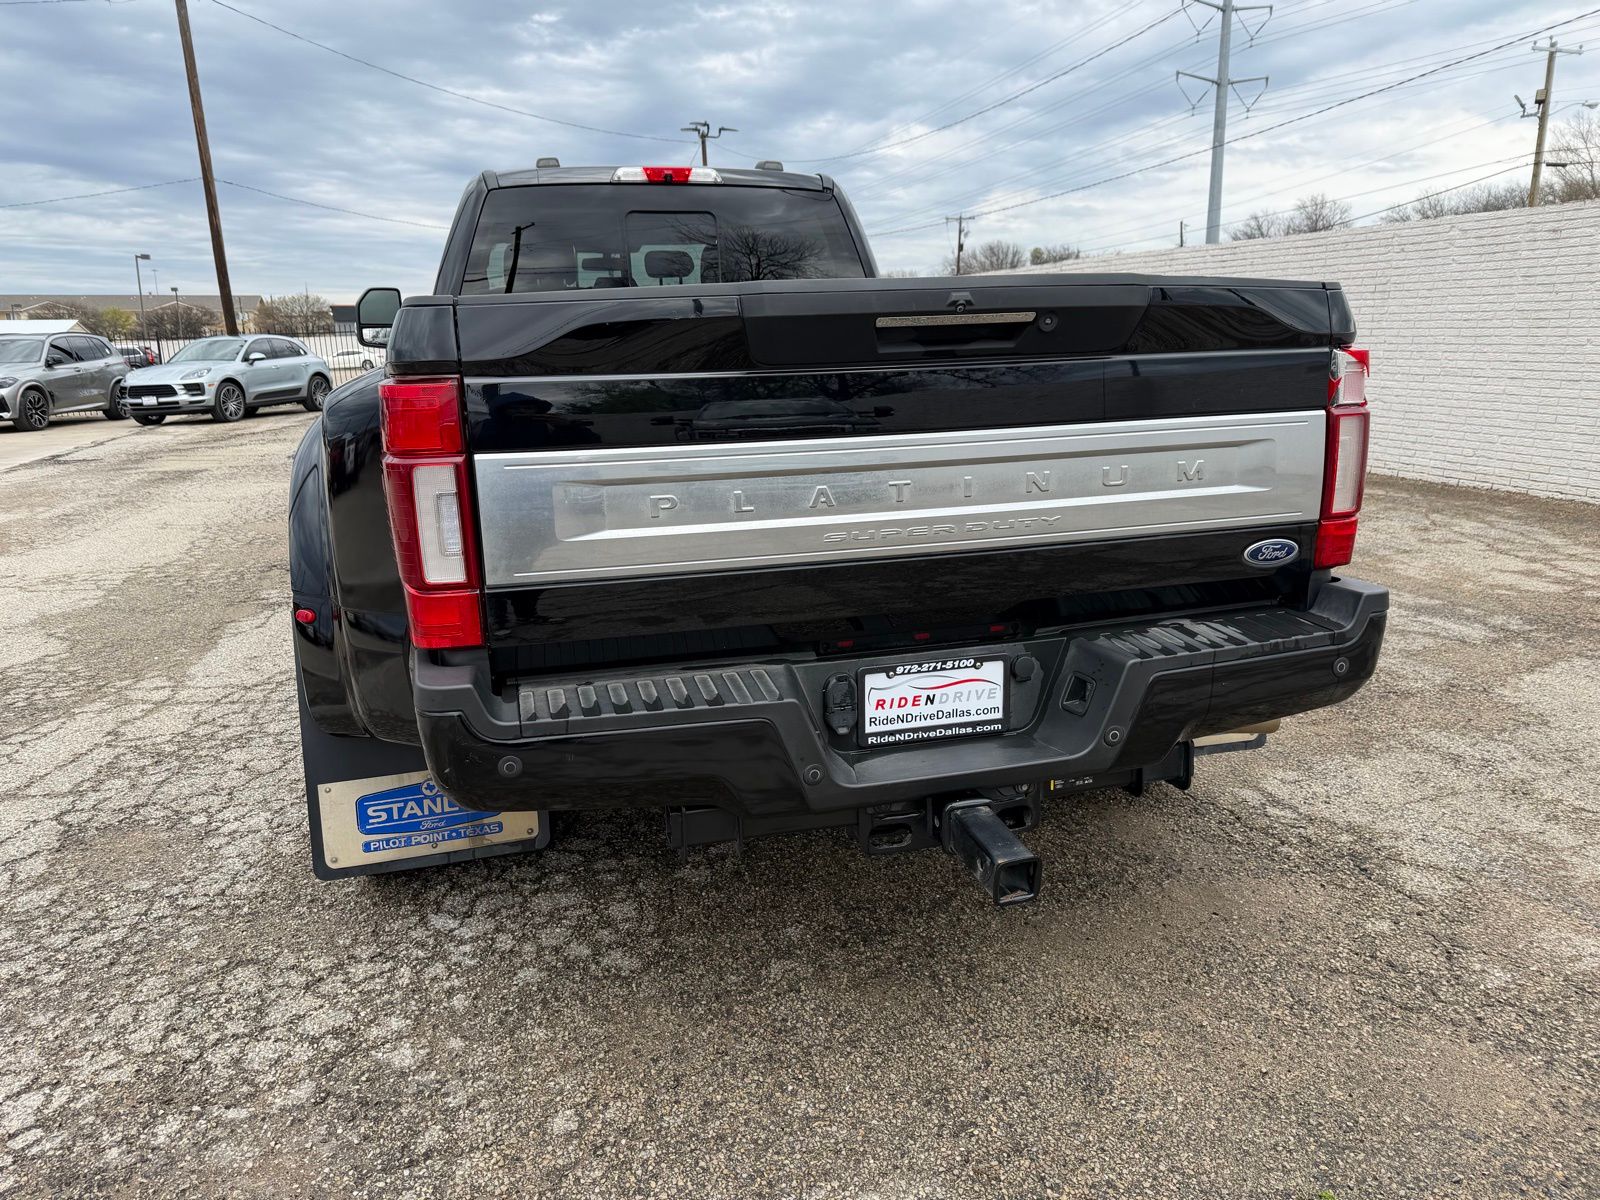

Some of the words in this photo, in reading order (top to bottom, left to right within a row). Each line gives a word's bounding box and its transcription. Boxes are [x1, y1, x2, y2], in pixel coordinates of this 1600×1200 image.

[649, 459, 1205, 519] PLATINUM
[823, 524, 955, 543] SUPER
[965, 515, 1062, 534] DUTY
[1257, 544, 1289, 560] Ford
[895, 658, 975, 675] 972-271-5100
[868, 706, 1001, 728] RideNDriveDallas.com
[867, 723, 1002, 745] RideNDriveDallas.com
[366, 796, 460, 824] STANL
[419, 819, 447, 830] Ford
[369, 838, 409, 852] PILOT
[410, 831, 451, 846] POINT
[458, 823, 500, 838] TEXAS
